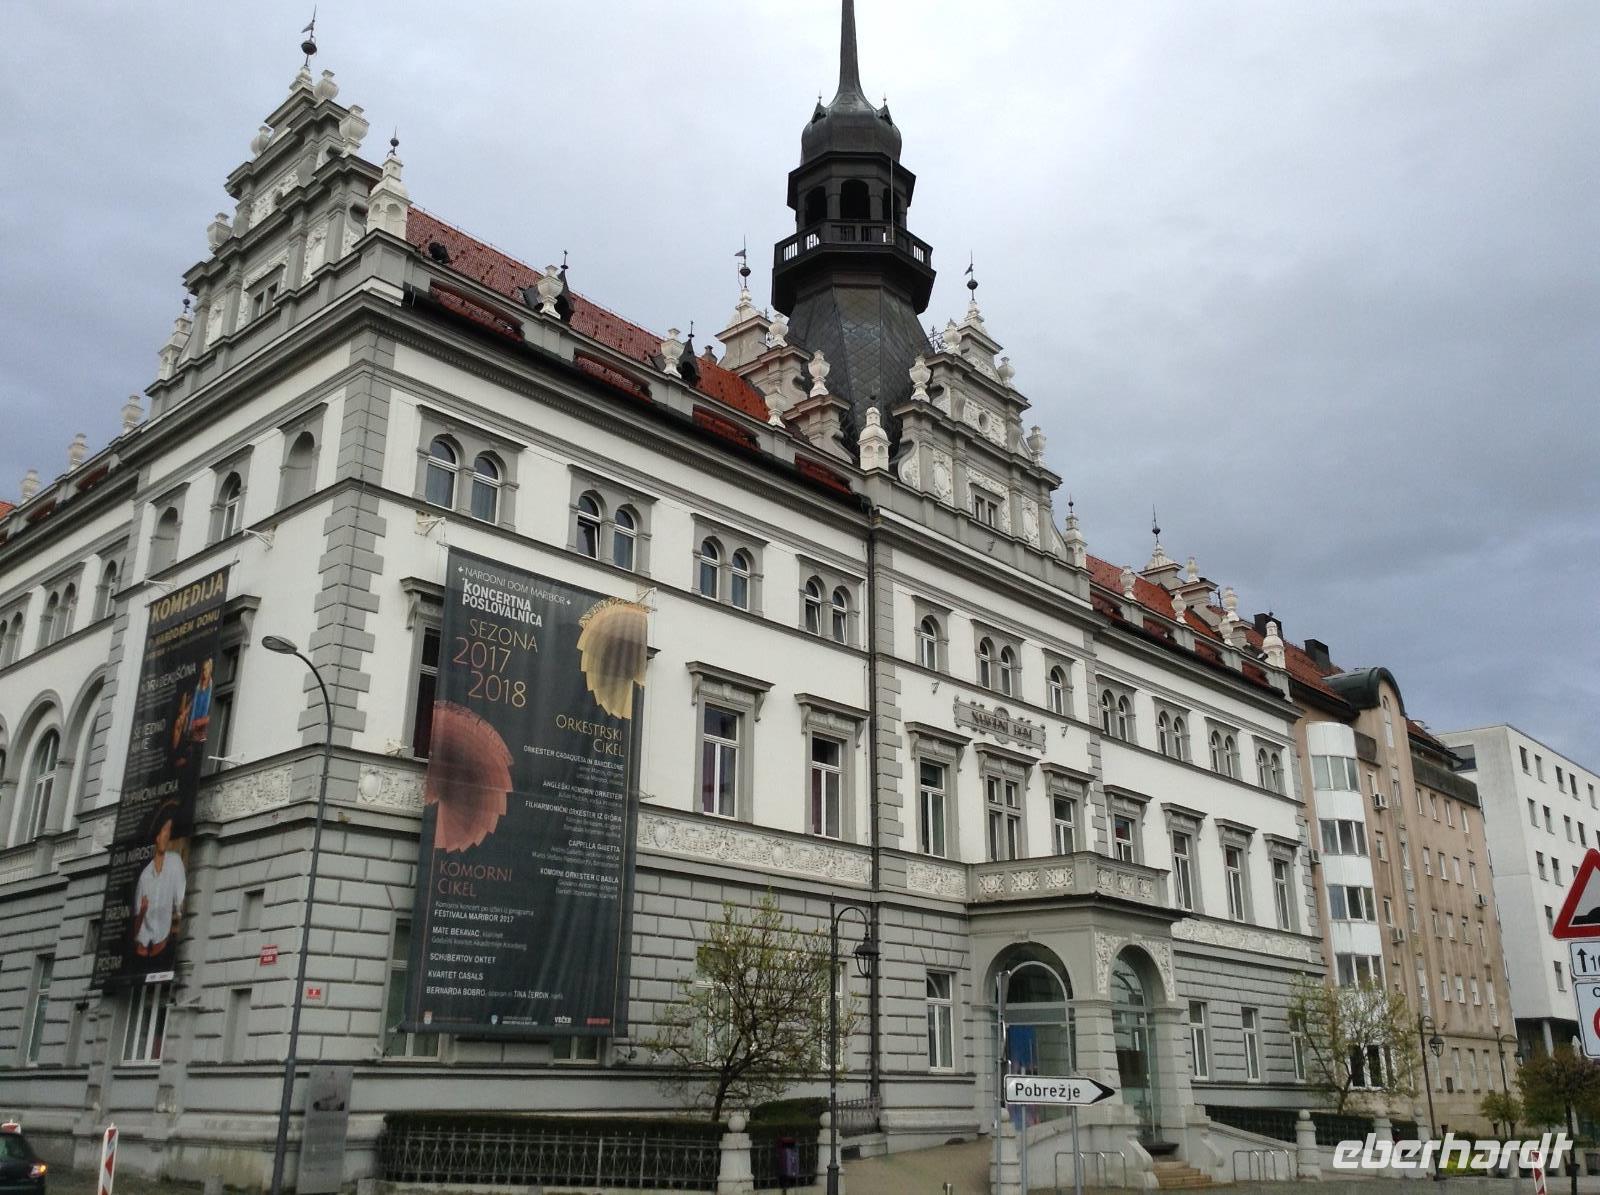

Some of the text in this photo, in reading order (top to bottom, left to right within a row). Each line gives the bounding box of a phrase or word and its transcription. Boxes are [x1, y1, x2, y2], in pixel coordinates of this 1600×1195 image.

[151, 572, 224, 625] KOMEDIJA
[465, 567, 566, 605] NARODNI DOM MARIBOR
[462, 593, 543, 628] POSLOVALNICA
[469, 618, 539, 653] SEZONA
[452, 636, 512, 673] 2017
[467, 670, 527, 708] 2018
[555, 714, 622, 742] ORKESTRSKI
[593, 738, 624, 757] CIKEL
[440, 860, 512, 882] KOMORNI
[437, 877, 477, 897] CIKEL
[434, 909, 467, 919] FESTIVALA
[468, 912, 499, 921] MARIBOR
[474, 955, 496, 964] OKTET
[427, 969, 484, 980] KVARTET CASALS
[1015, 1083, 1080, 1101] Pobrežje
